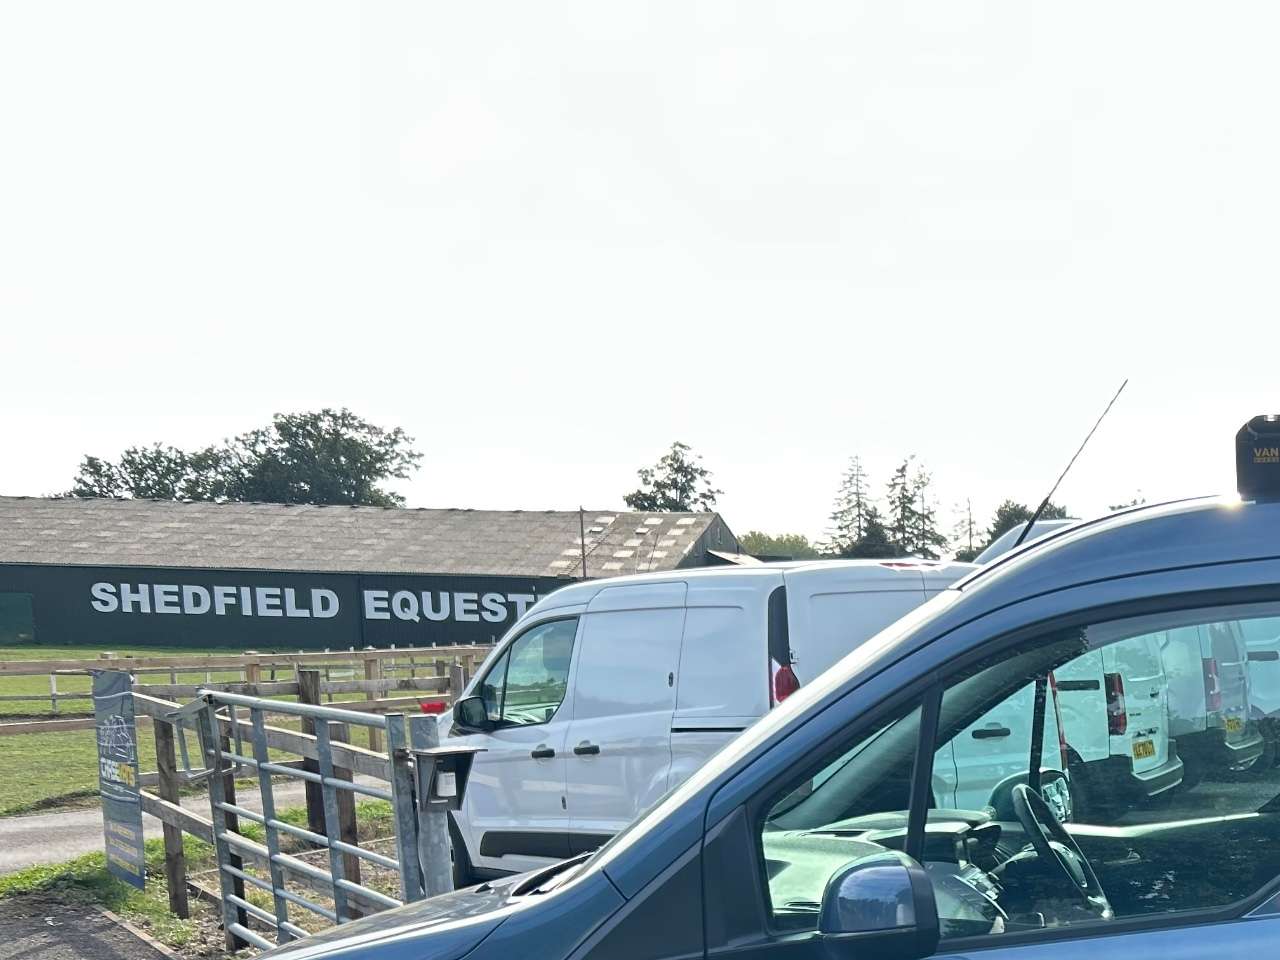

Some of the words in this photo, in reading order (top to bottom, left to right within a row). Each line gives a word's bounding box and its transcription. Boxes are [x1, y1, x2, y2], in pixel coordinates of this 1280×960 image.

[1253, 447, 1280, 457] VAN
[90, 582, 340, 619] SHEDFIELD
[363, 590, 547, 624] EQUEST
